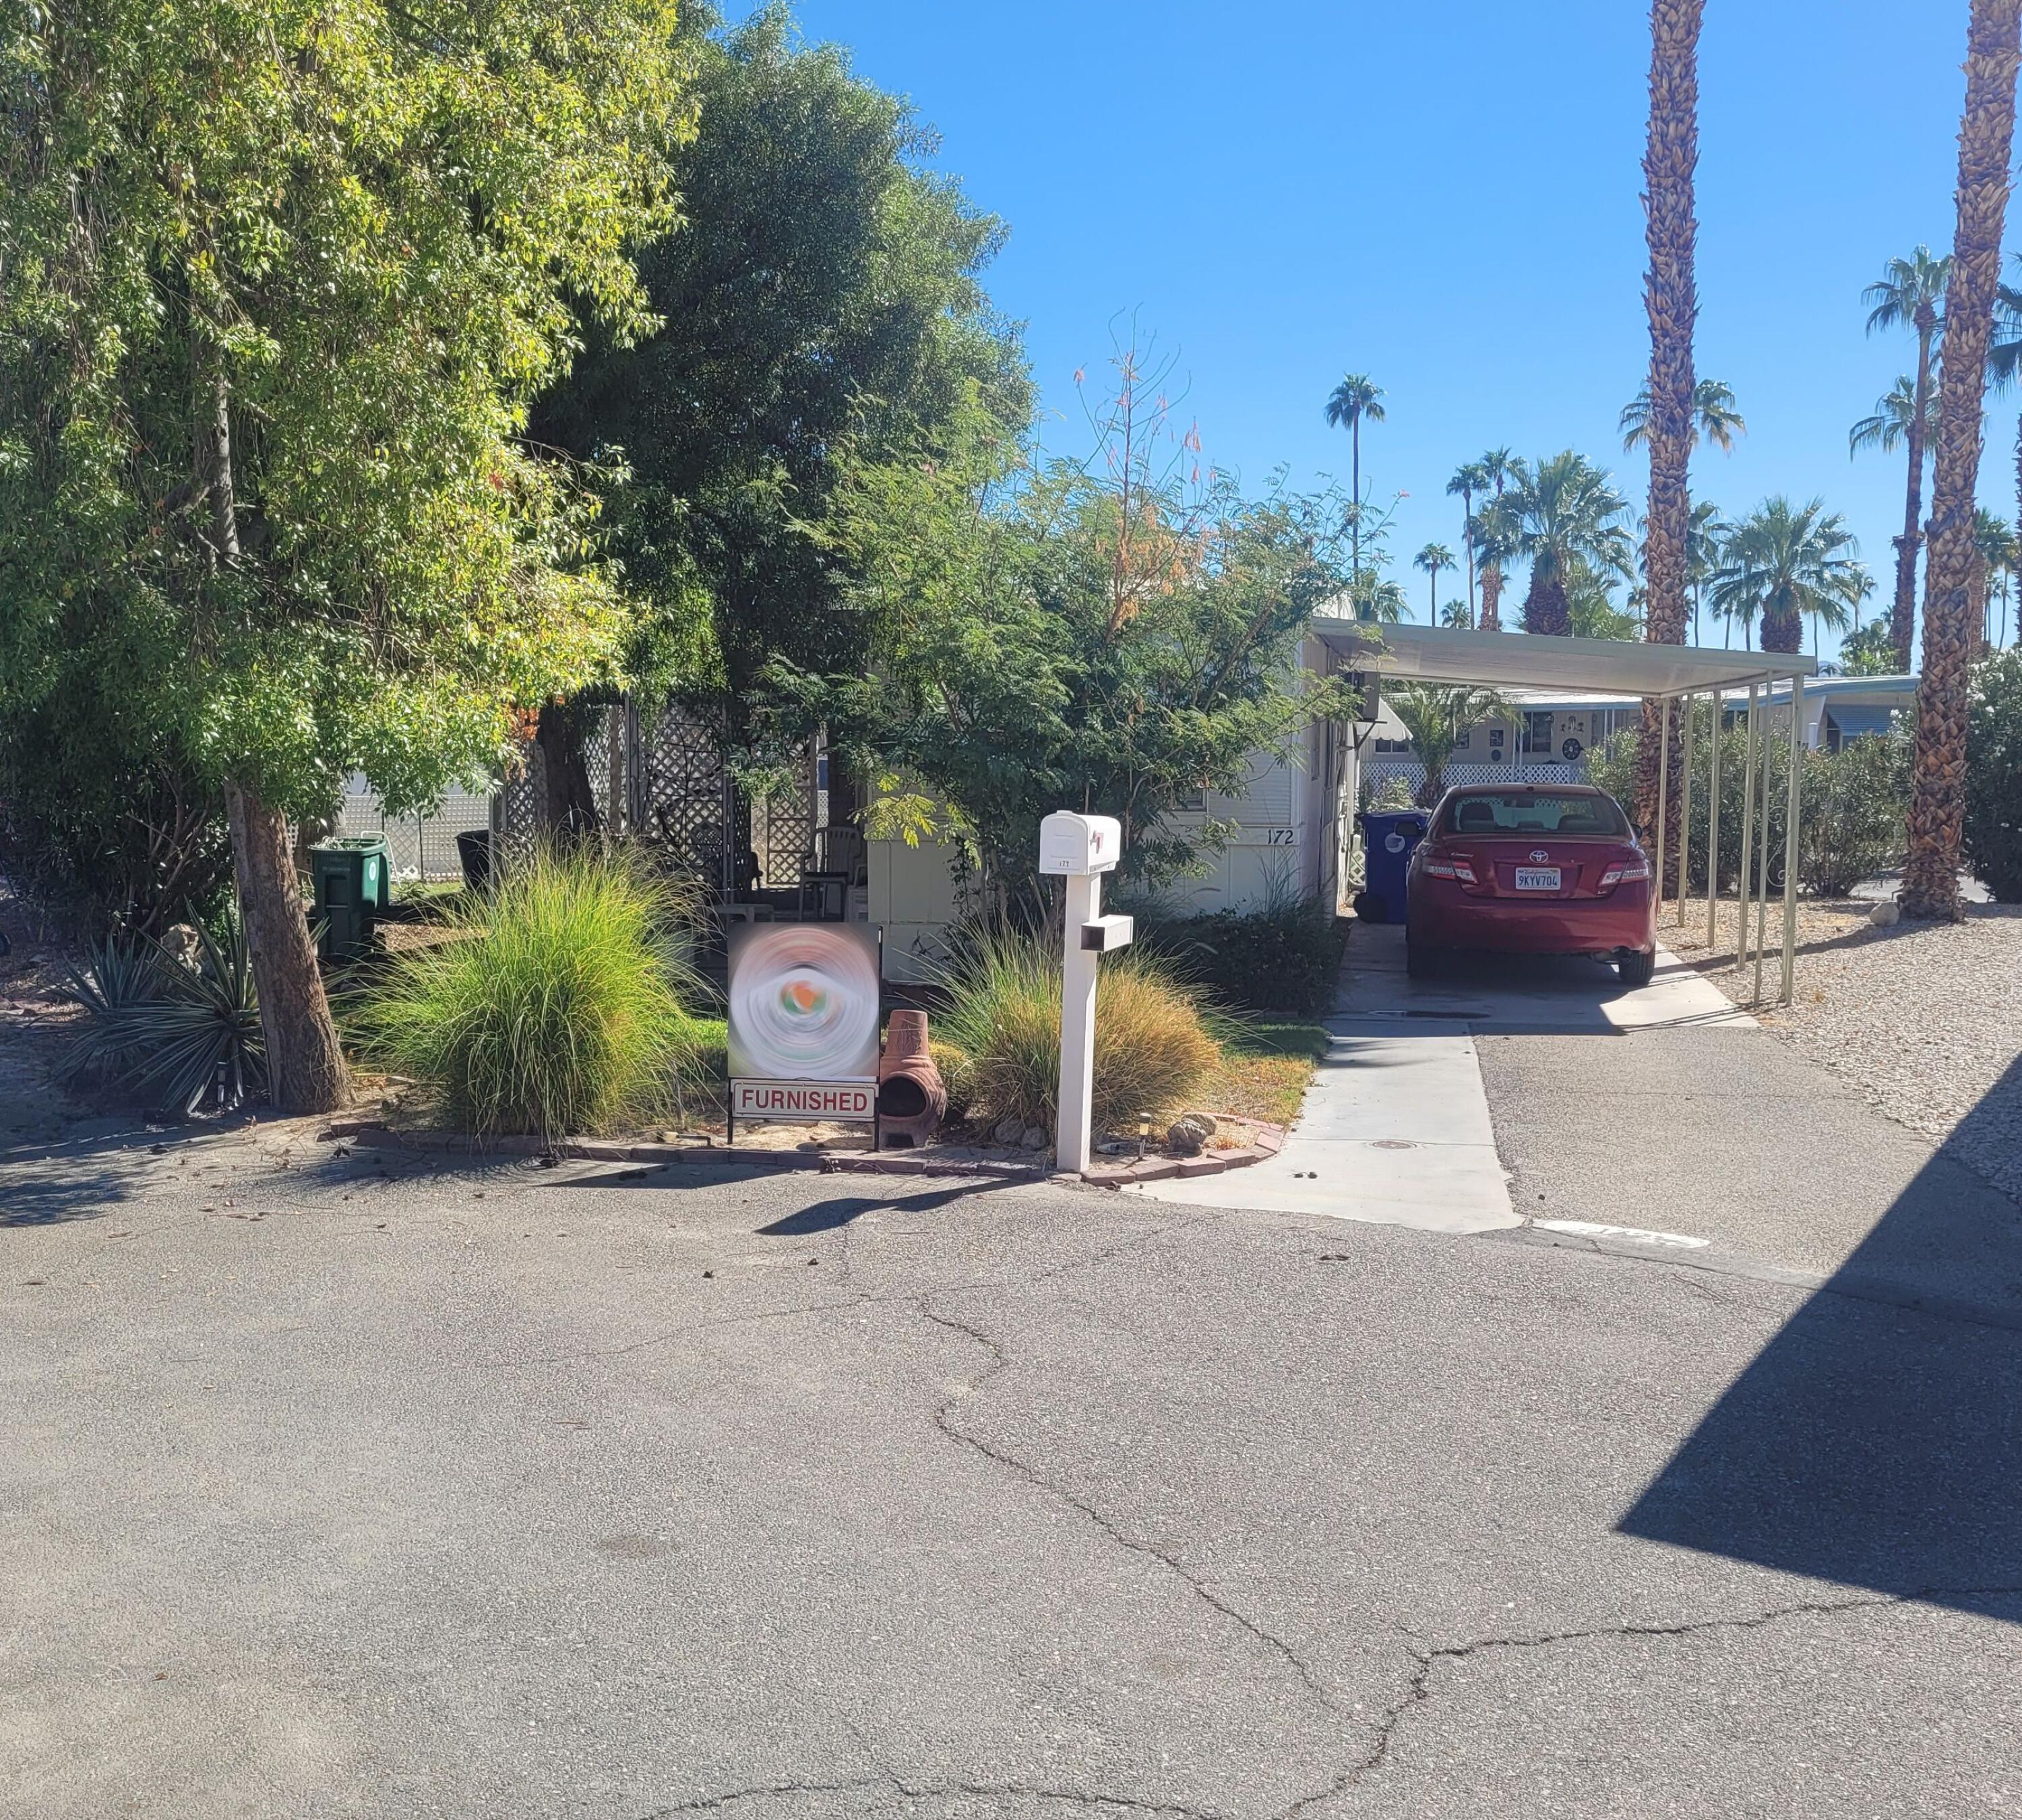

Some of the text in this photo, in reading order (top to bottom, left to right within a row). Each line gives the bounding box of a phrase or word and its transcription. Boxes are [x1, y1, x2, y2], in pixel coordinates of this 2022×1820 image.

[1268, 829, 1293, 845] 172
[1518, 876, 1558, 886] 9KYV704
[742, 1089, 867, 1112] FURNISHED
